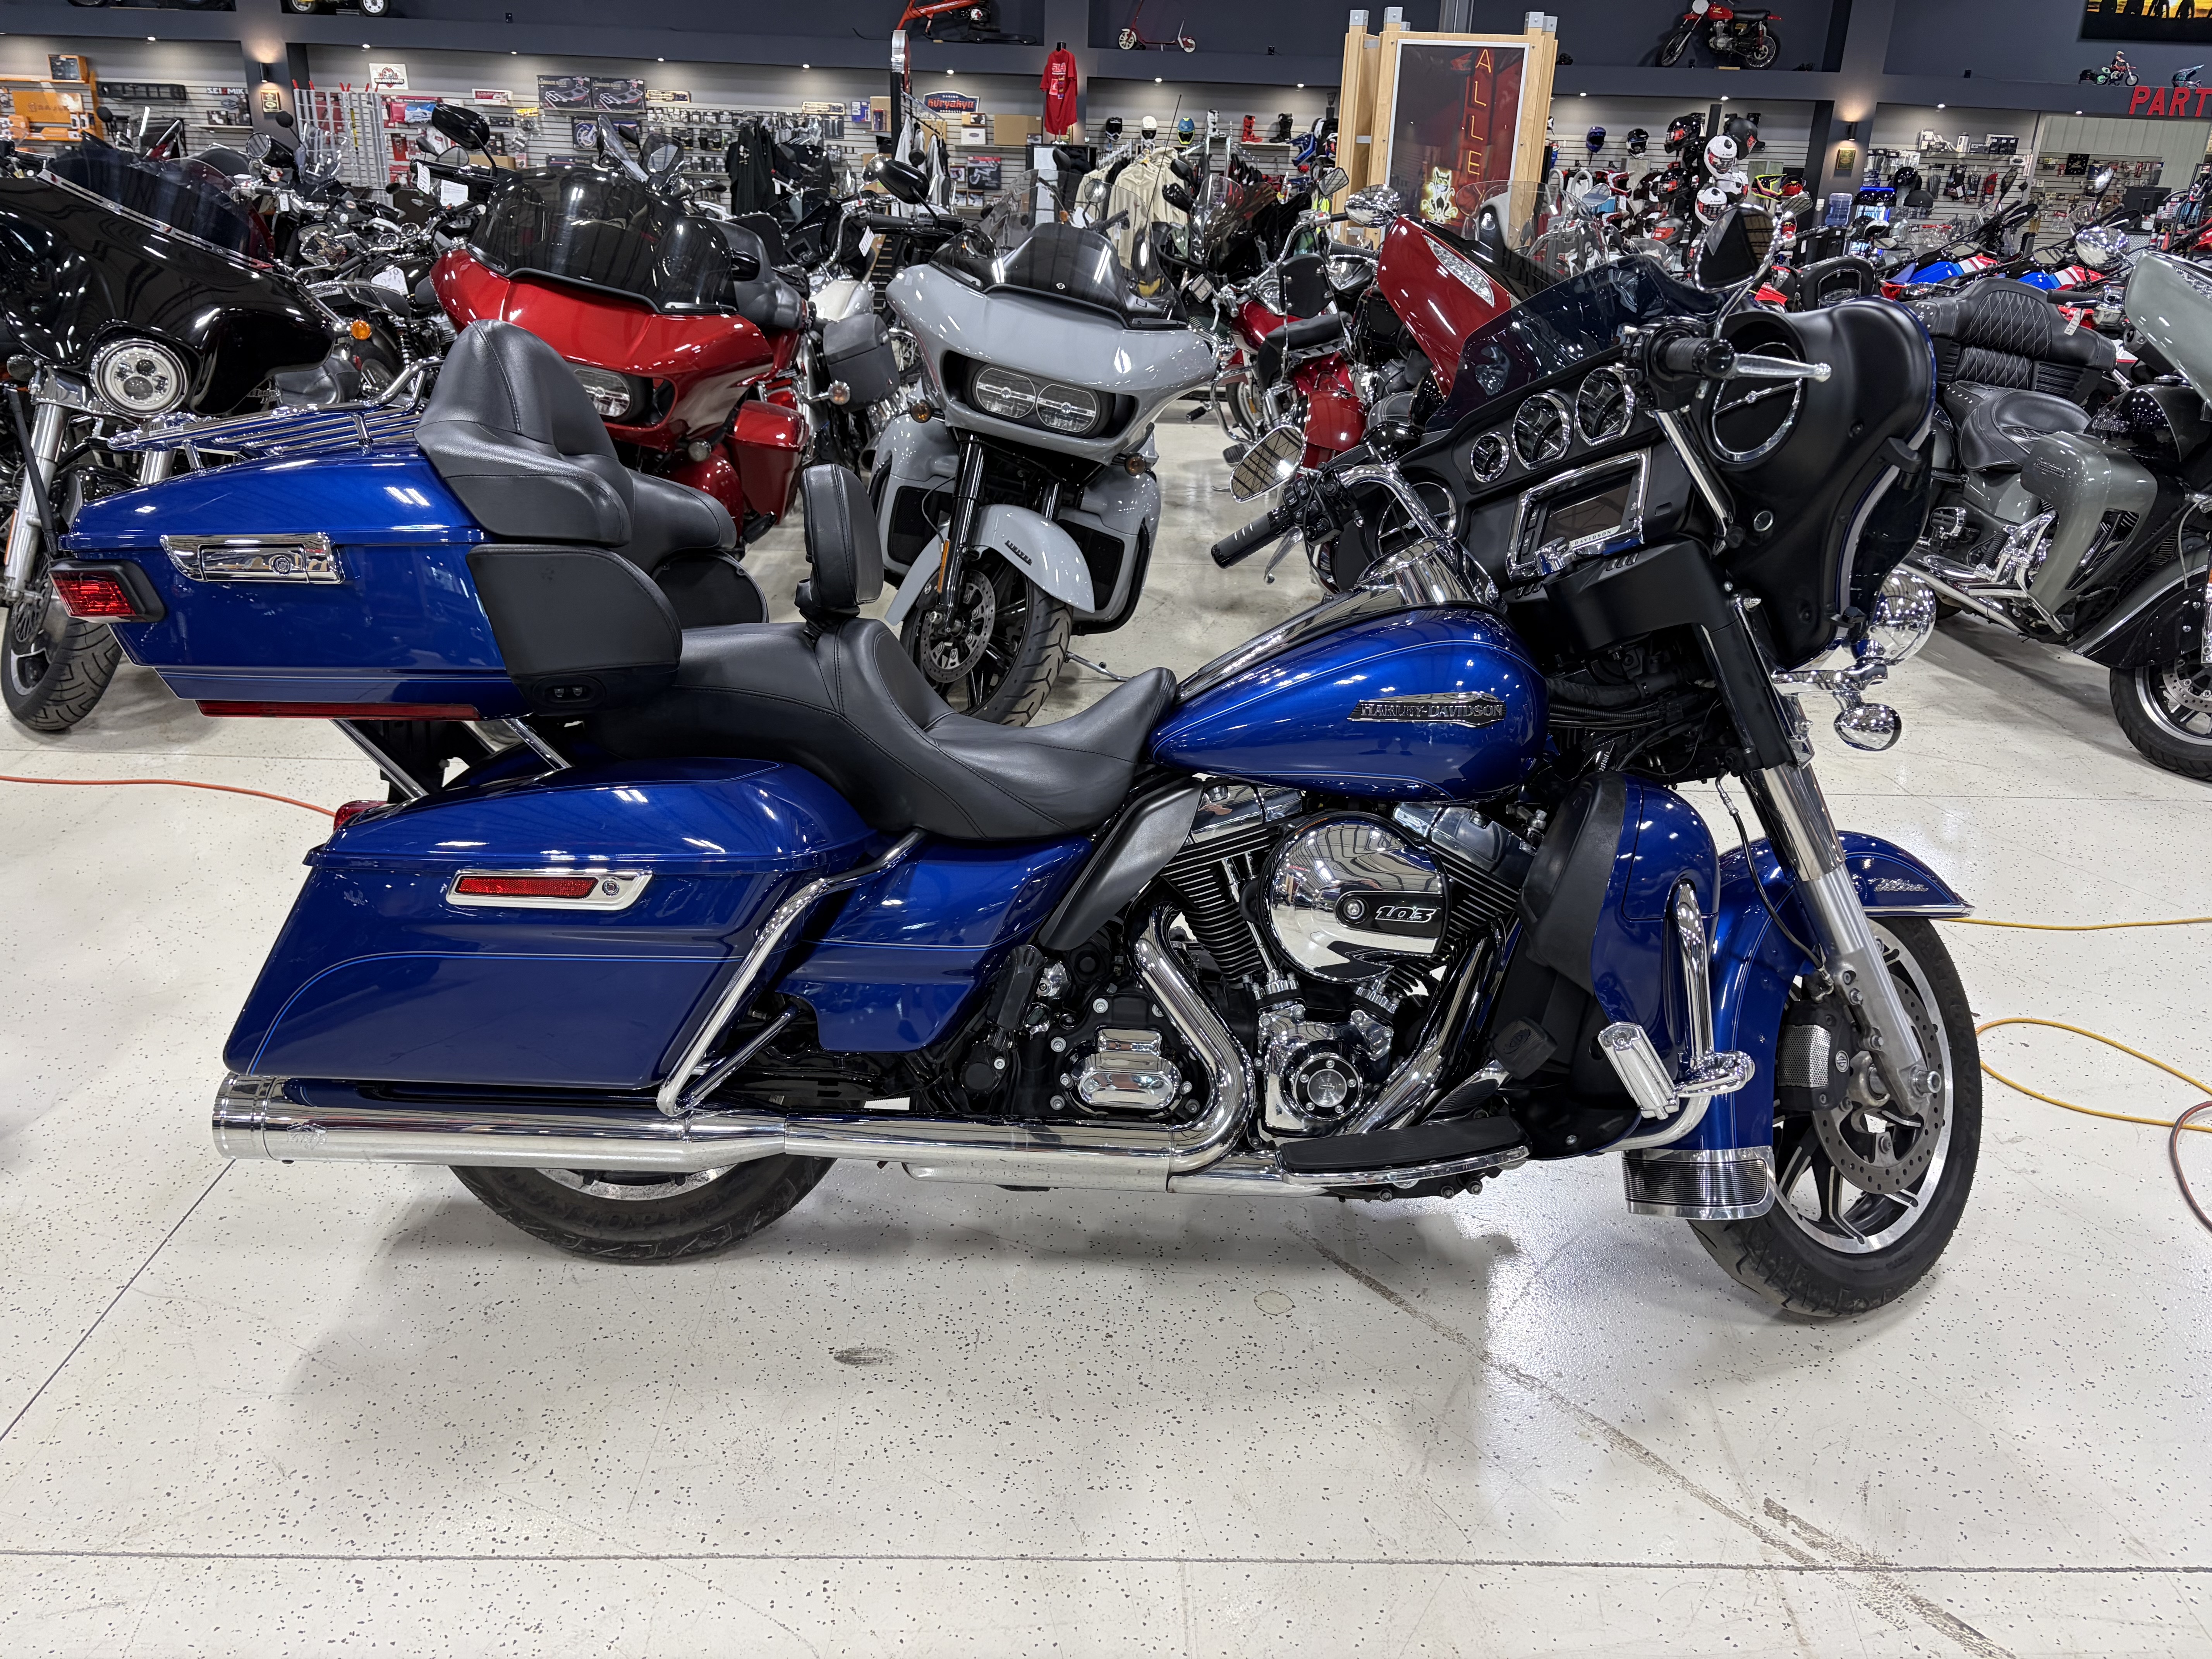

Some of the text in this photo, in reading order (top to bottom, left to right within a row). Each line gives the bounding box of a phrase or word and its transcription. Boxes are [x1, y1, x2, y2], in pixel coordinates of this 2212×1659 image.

[2129, 86, 2212, 117] PART
[1005, 540, 1033, 566] LIMITED
[1360, 703, 1504, 717] HARLEY-DAVIDSON
[1375, 905, 1437, 923] 103
